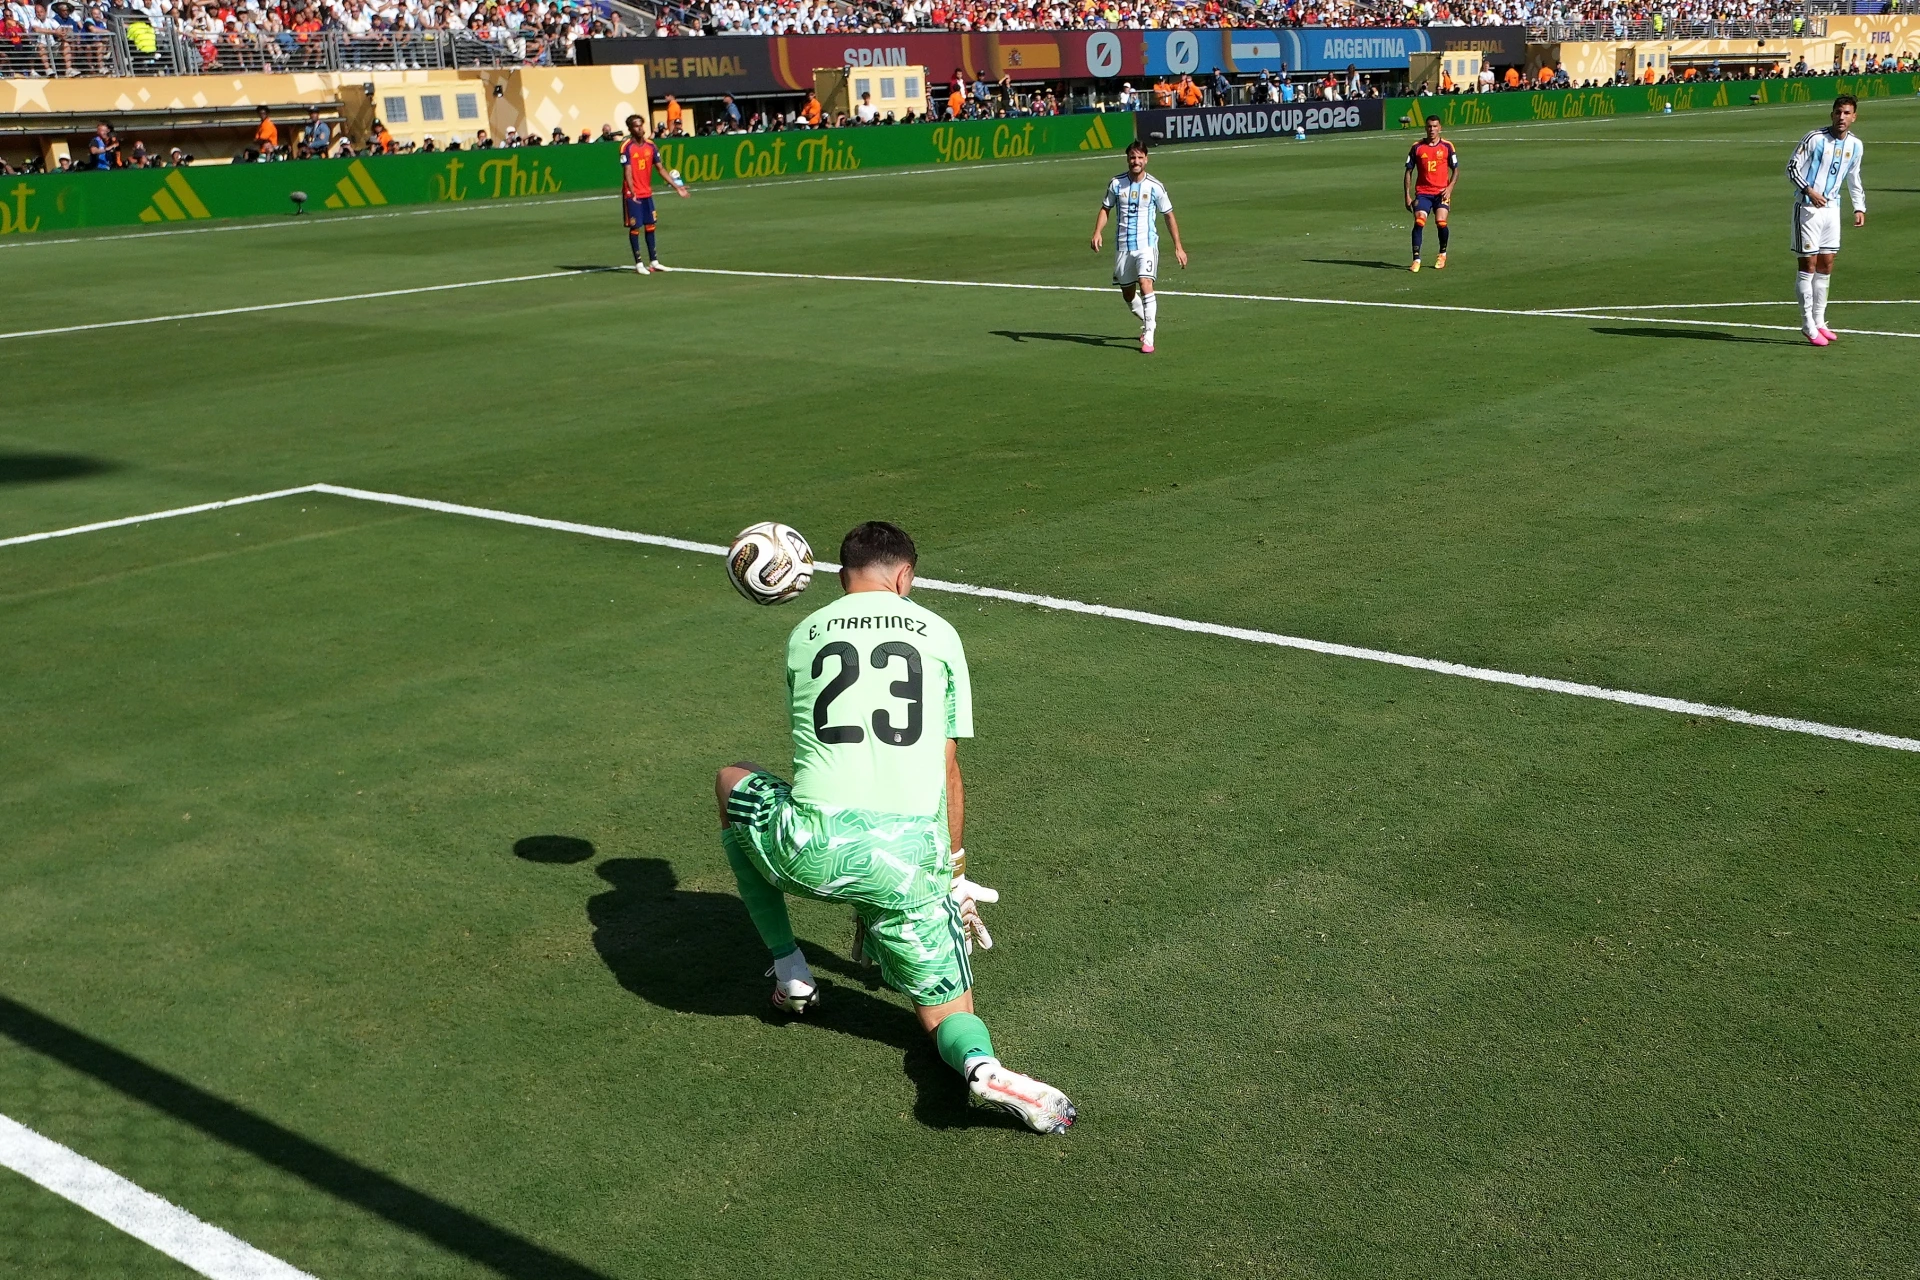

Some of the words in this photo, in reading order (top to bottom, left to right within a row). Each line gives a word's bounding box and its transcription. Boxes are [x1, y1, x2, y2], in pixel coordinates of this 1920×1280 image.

[1323, 38, 1405, 59] ARGENTINA
[1445, 40, 1469, 51] THE
[1470, 40, 1505, 53] FINAL
[1871, 31, 1891, 44] FIFA
[682, 56, 747, 77] FINAL
[843, 47, 907, 67] SPAIN
[1532, 93, 1558, 119] You
[1562, 92, 1586, 118] Got
[1589, 91, 1616, 116] This
[1674, 87, 1693, 110] Got
[1166, 115, 1204, 139] FIFA
[1206, 111, 1268, 136] WORLD
[1270, 109, 1303, 132] CUP
[1305, 106, 1361, 130] 2026
[1461, 98, 1493, 125] This
[933, 127, 984, 163] You
[993, 122, 1035, 158] Got
[659, 143, 724, 185] You
[734, 137, 787, 179] Got
[797, 135, 861, 173] This
[1427, 160, 1437, 172] 12
[479, 154, 562, 198] This
[1129, 202, 1138, 214] 3
[1146, 260, 1153, 273] 3
[809, 624, 820, 641] E.
[826, 615, 928, 637] MARTINEZ
[811, 641, 923, 747] 23
